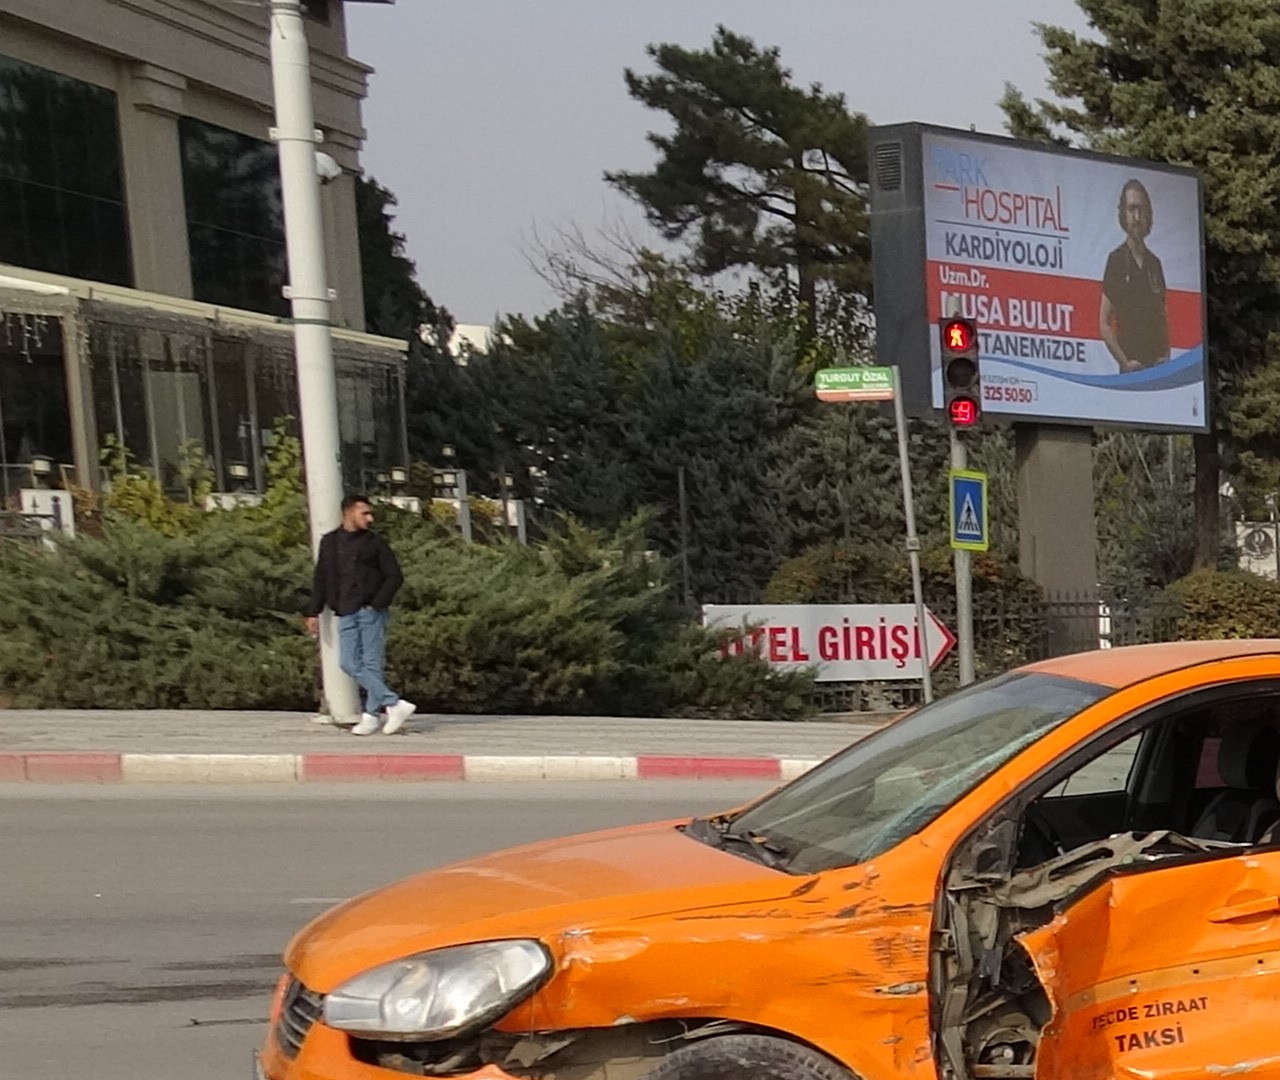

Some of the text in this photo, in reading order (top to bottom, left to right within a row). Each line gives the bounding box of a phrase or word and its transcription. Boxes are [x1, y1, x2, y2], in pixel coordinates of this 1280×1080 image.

[964, 185, 1070, 232] HOSPITAL
[945, 231, 1063, 270] KARDİYOLOJİ
[1008, 298, 1074, 333] BULUT
[820, 372, 860, 383] TURGUT
[984, 385, 1003, 402] 325
[818, 617, 922, 668] GİRİŞİ
[1143, 996, 1208, 1018] ZİRAAT
[1114, 1021, 1184, 1053] TAKSİ
